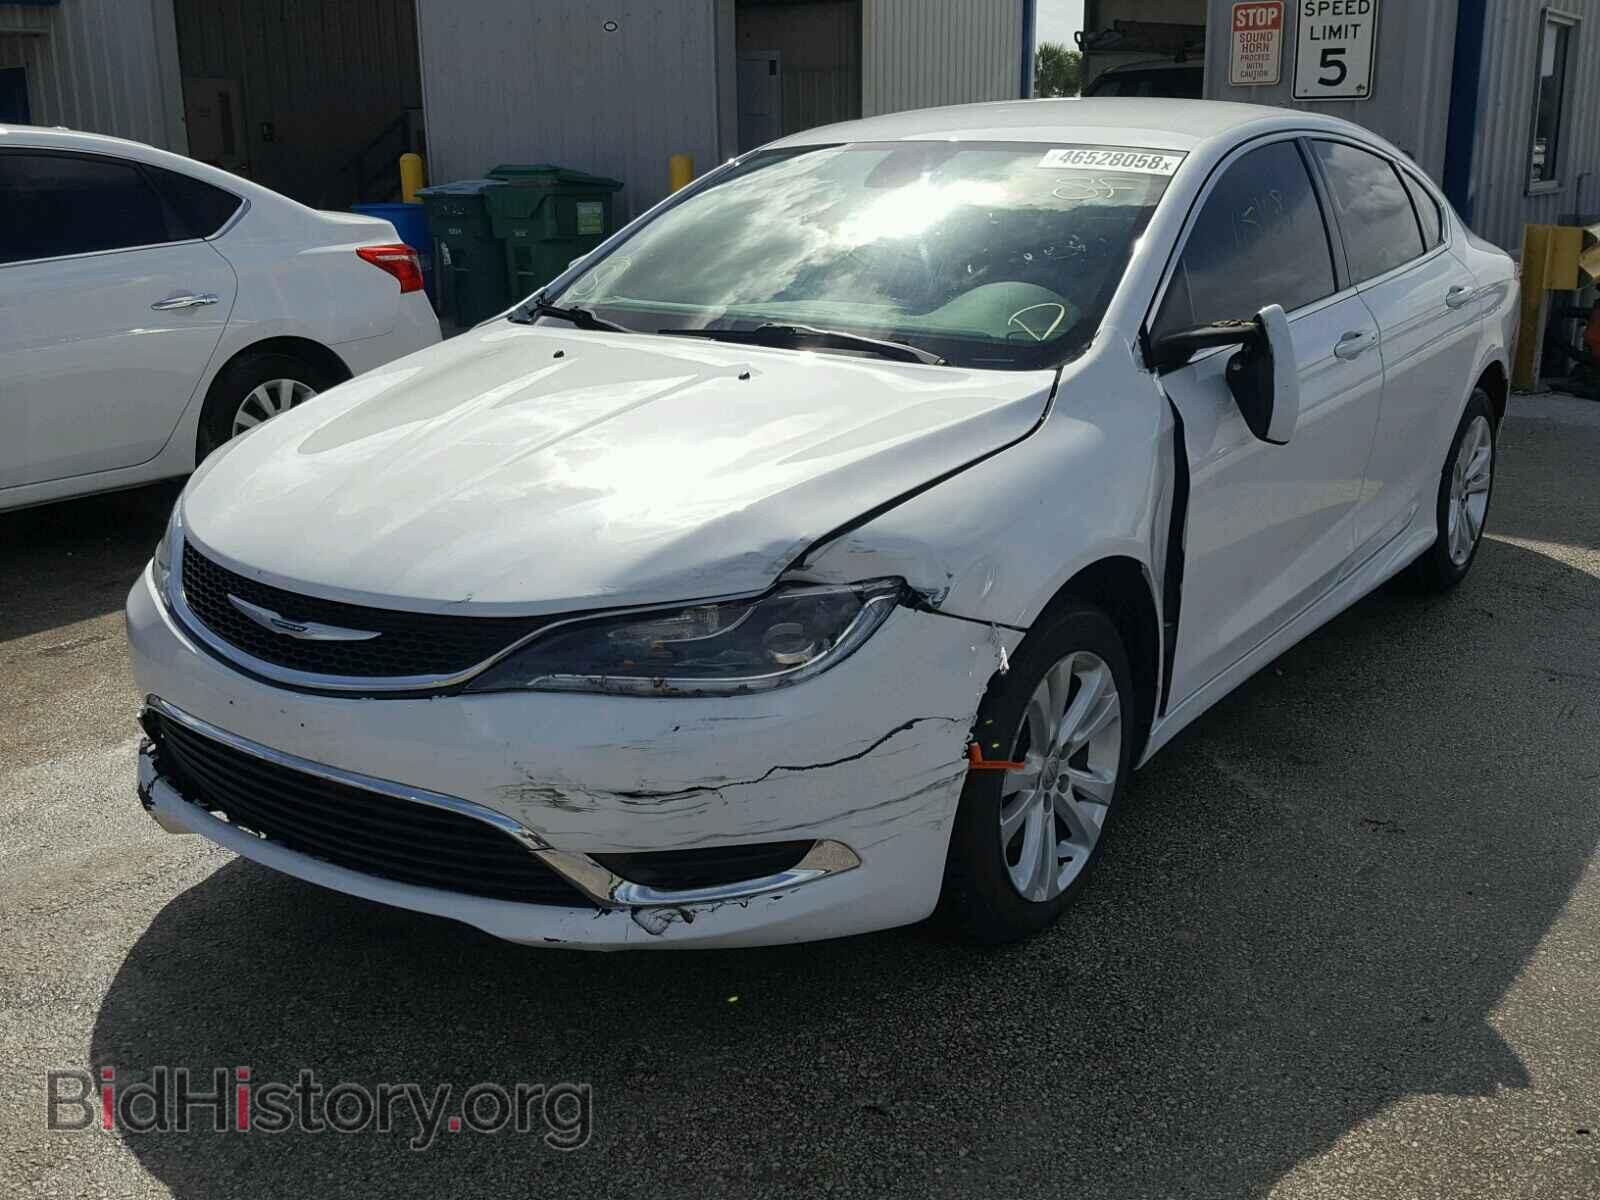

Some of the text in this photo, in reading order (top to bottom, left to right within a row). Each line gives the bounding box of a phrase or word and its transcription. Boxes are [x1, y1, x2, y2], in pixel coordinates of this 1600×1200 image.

[1304, 0, 1370, 17] SPEED
[1236, 8, 1278, 27] STOP
[1240, 31, 1273, 43] SOUND
[1310, 24, 1361, 40] LIMIT
[1242, 42, 1269, 53] HORN
[1318, 48, 1347, 86] 5
